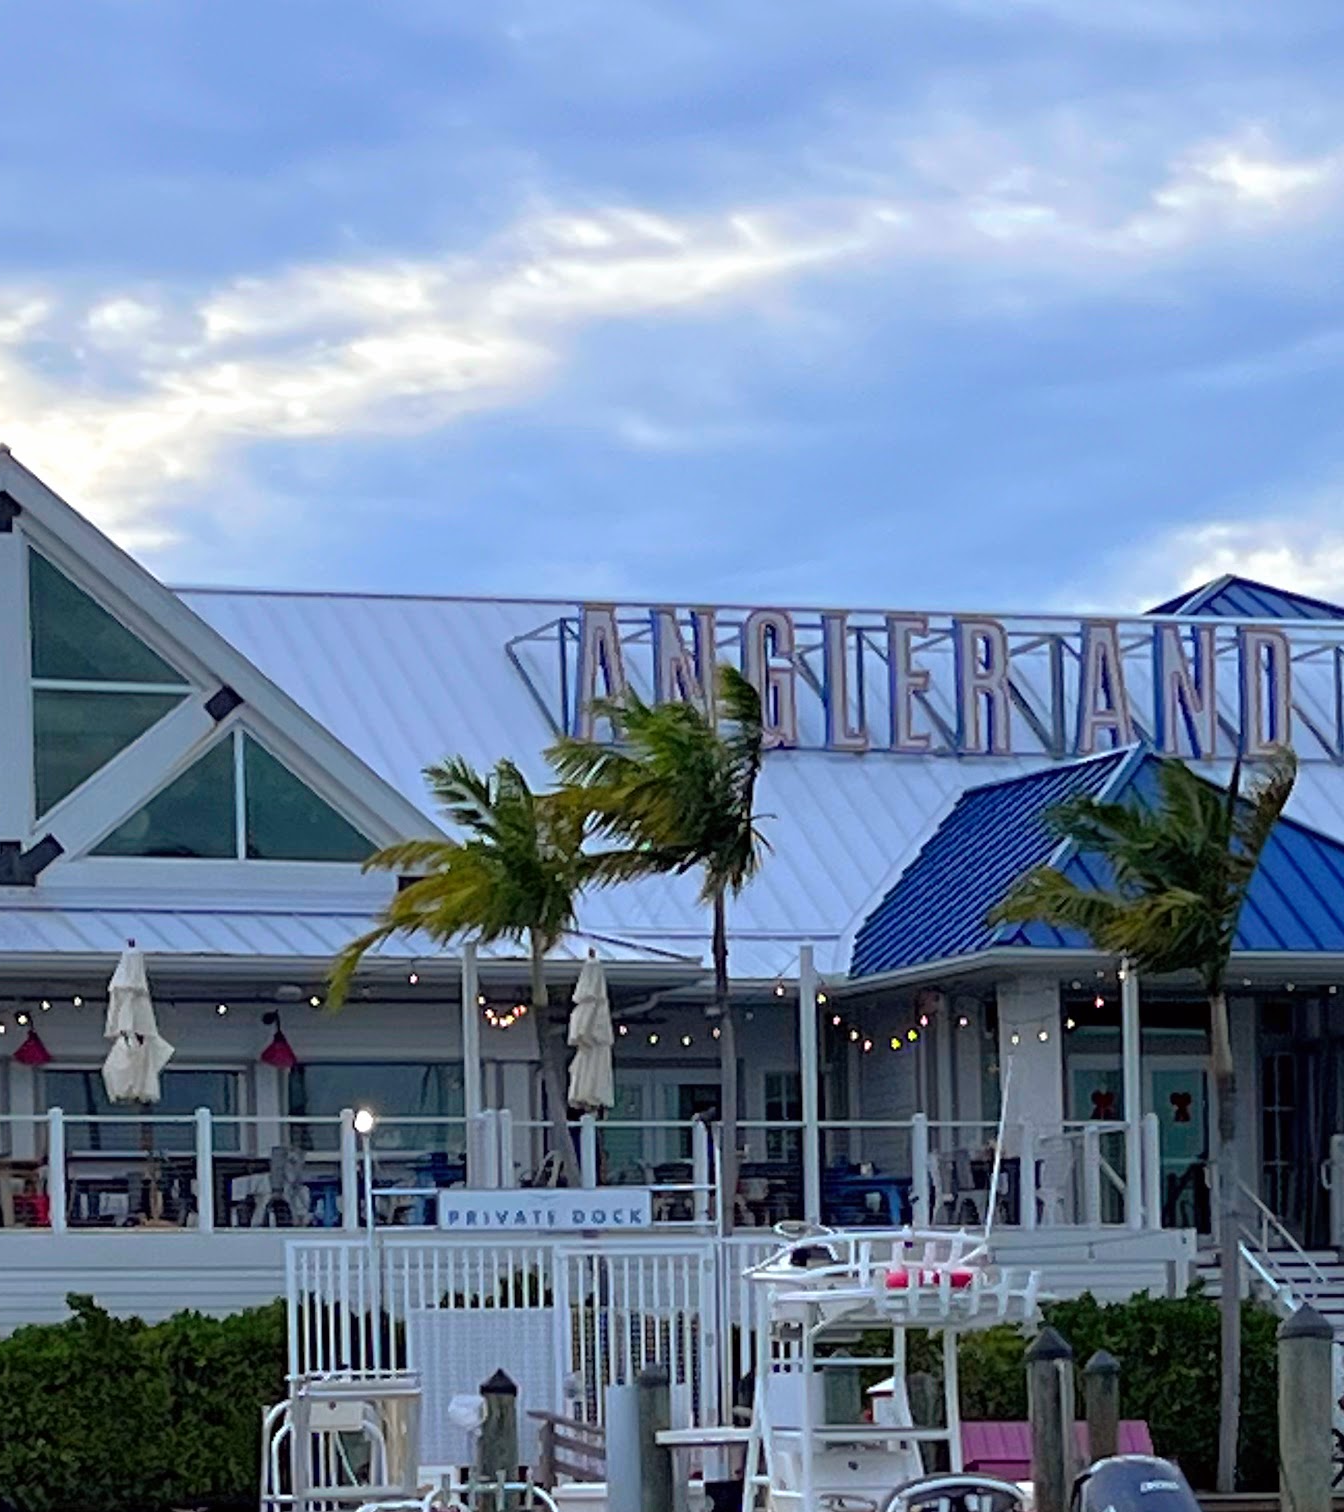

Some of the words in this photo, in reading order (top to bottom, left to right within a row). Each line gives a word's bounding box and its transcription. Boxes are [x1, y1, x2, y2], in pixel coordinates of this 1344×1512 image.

[573, 602, 1010, 755] ANGLER
[1074, 617, 1291, 760] AND
[447, 1209, 555, 1227] PRIVATE
[571, 1208, 643, 1225] DOCK
